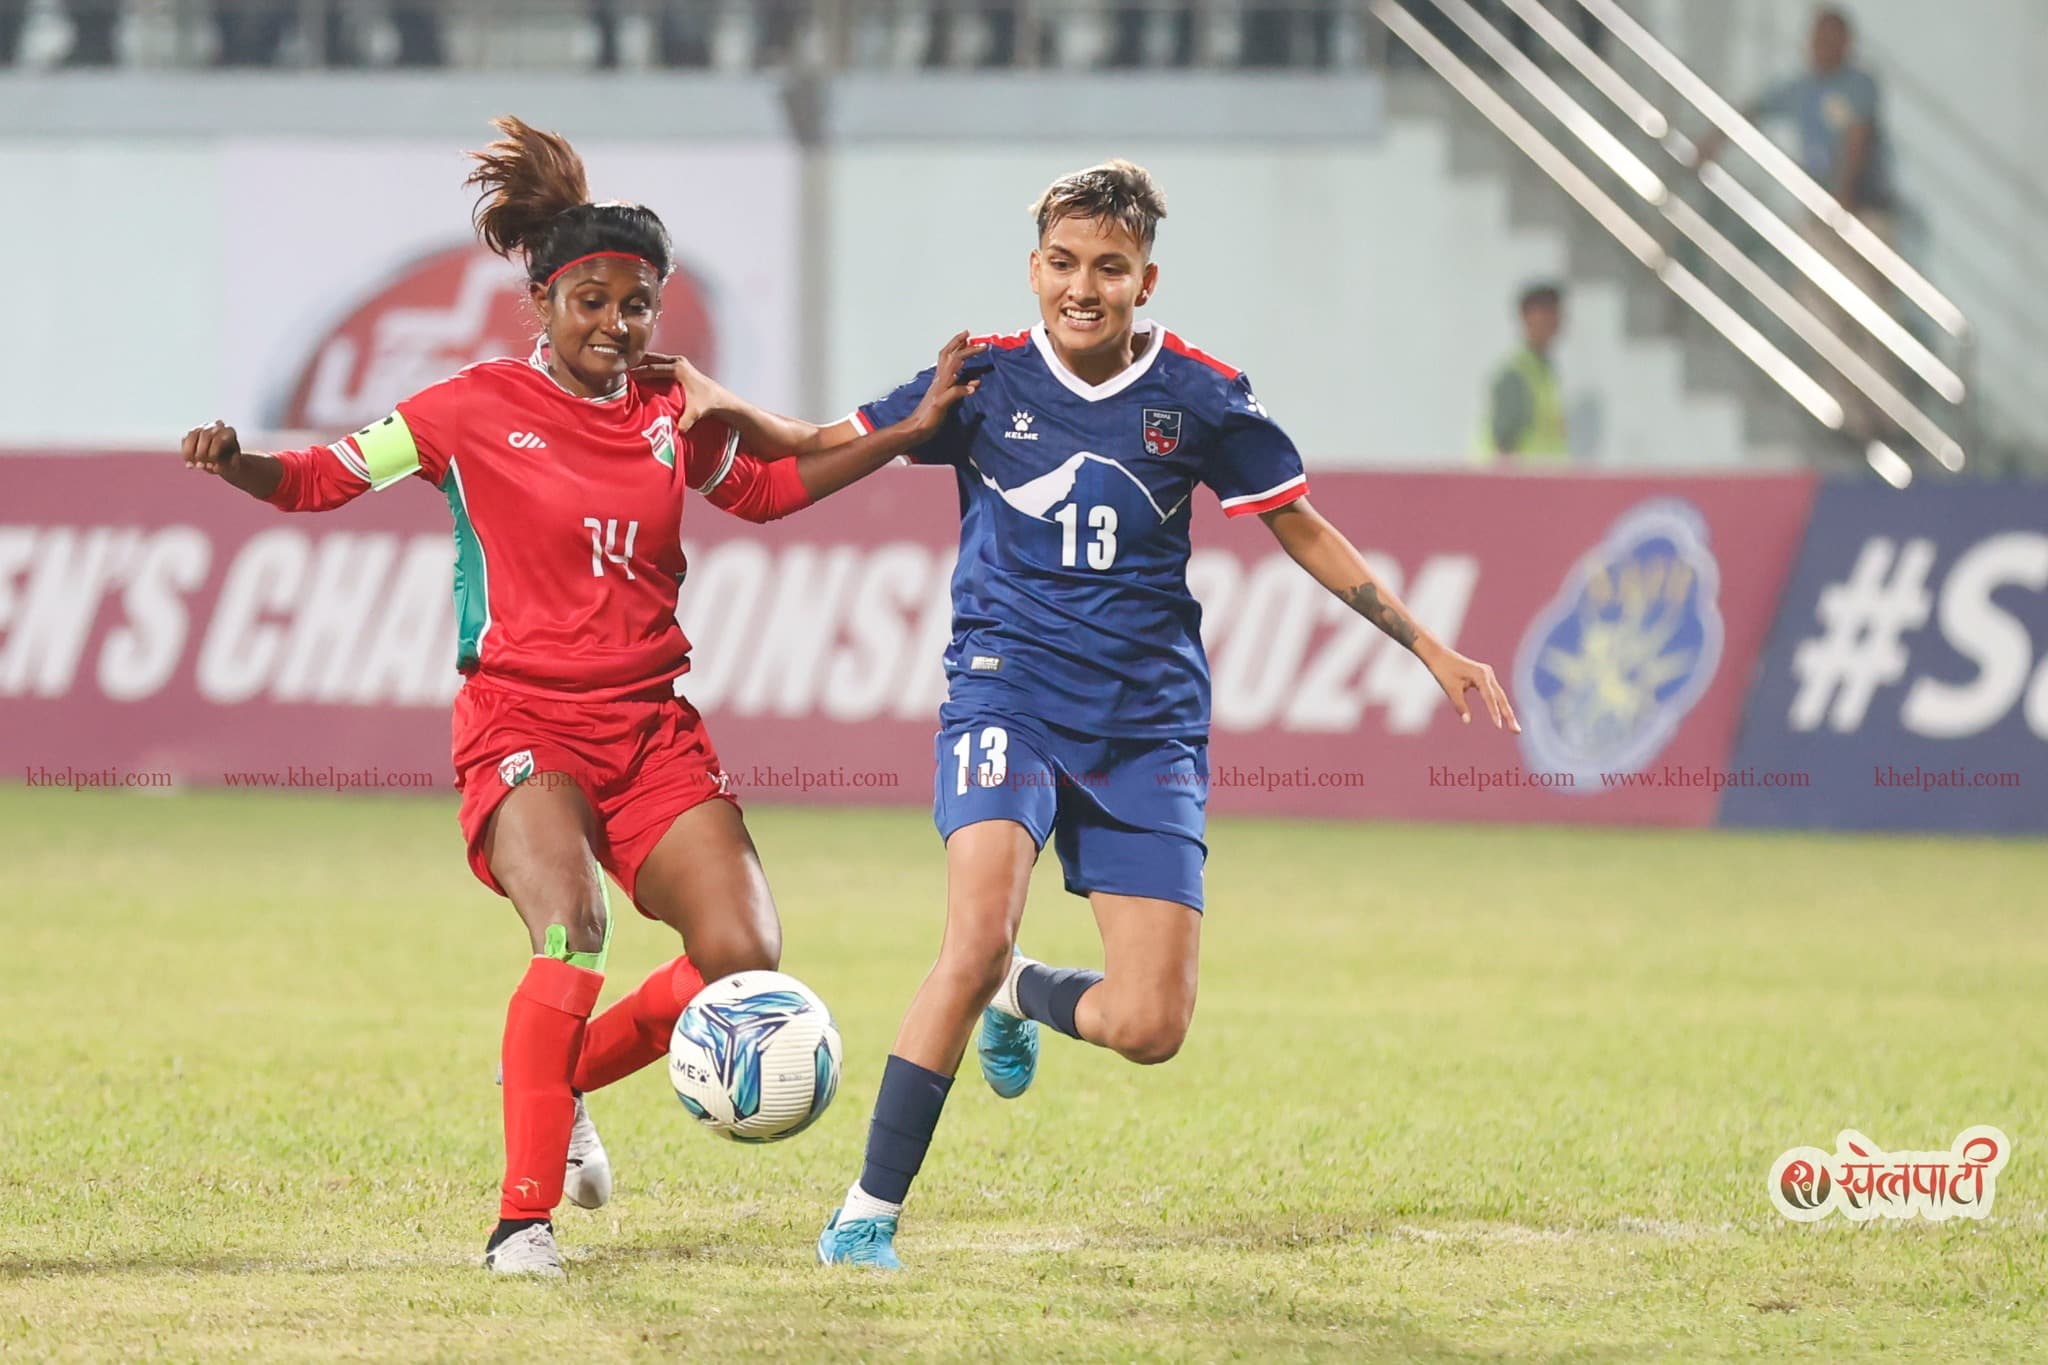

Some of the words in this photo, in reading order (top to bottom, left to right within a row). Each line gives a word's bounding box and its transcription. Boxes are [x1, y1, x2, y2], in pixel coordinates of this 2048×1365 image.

[1004, 431, 1039, 441] KELME
[583, 516, 640, 580] 14
[1054, 502, 1119, 571] 13
[1787, 532, 2048, 740] #S
[952, 726, 1009, 797] 13
